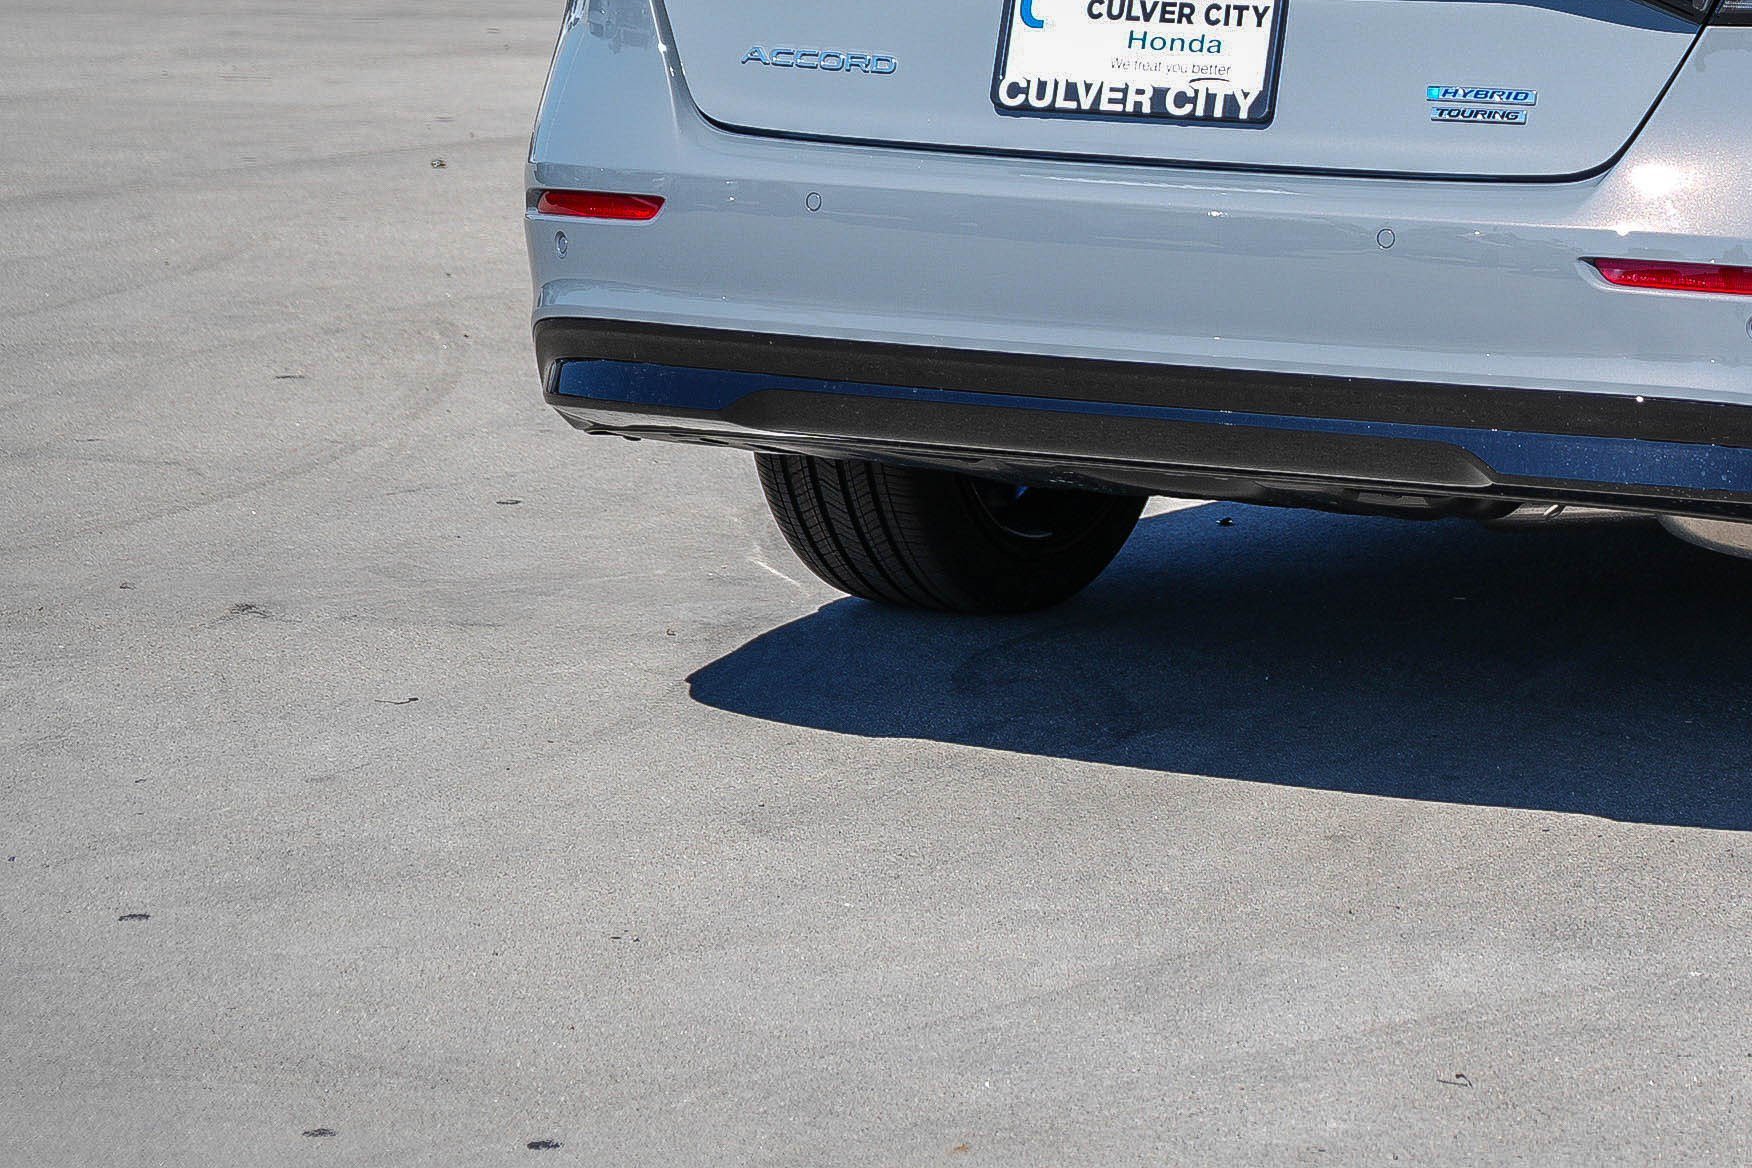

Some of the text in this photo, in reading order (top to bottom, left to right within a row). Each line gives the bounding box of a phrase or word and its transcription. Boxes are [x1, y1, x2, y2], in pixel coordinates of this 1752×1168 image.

[1204, 3, 1271, 28] CITY
[1127, 30, 1222, 54] Honda
[741, 46, 897, 74] ACCORD
[1111, 57, 1232, 75] We treat you better
[998, 77, 1263, 119] CULVER CITY
[1441, 88, 1529, 101] HYBRID
[1436, 108, 1520, 120] TOURING
